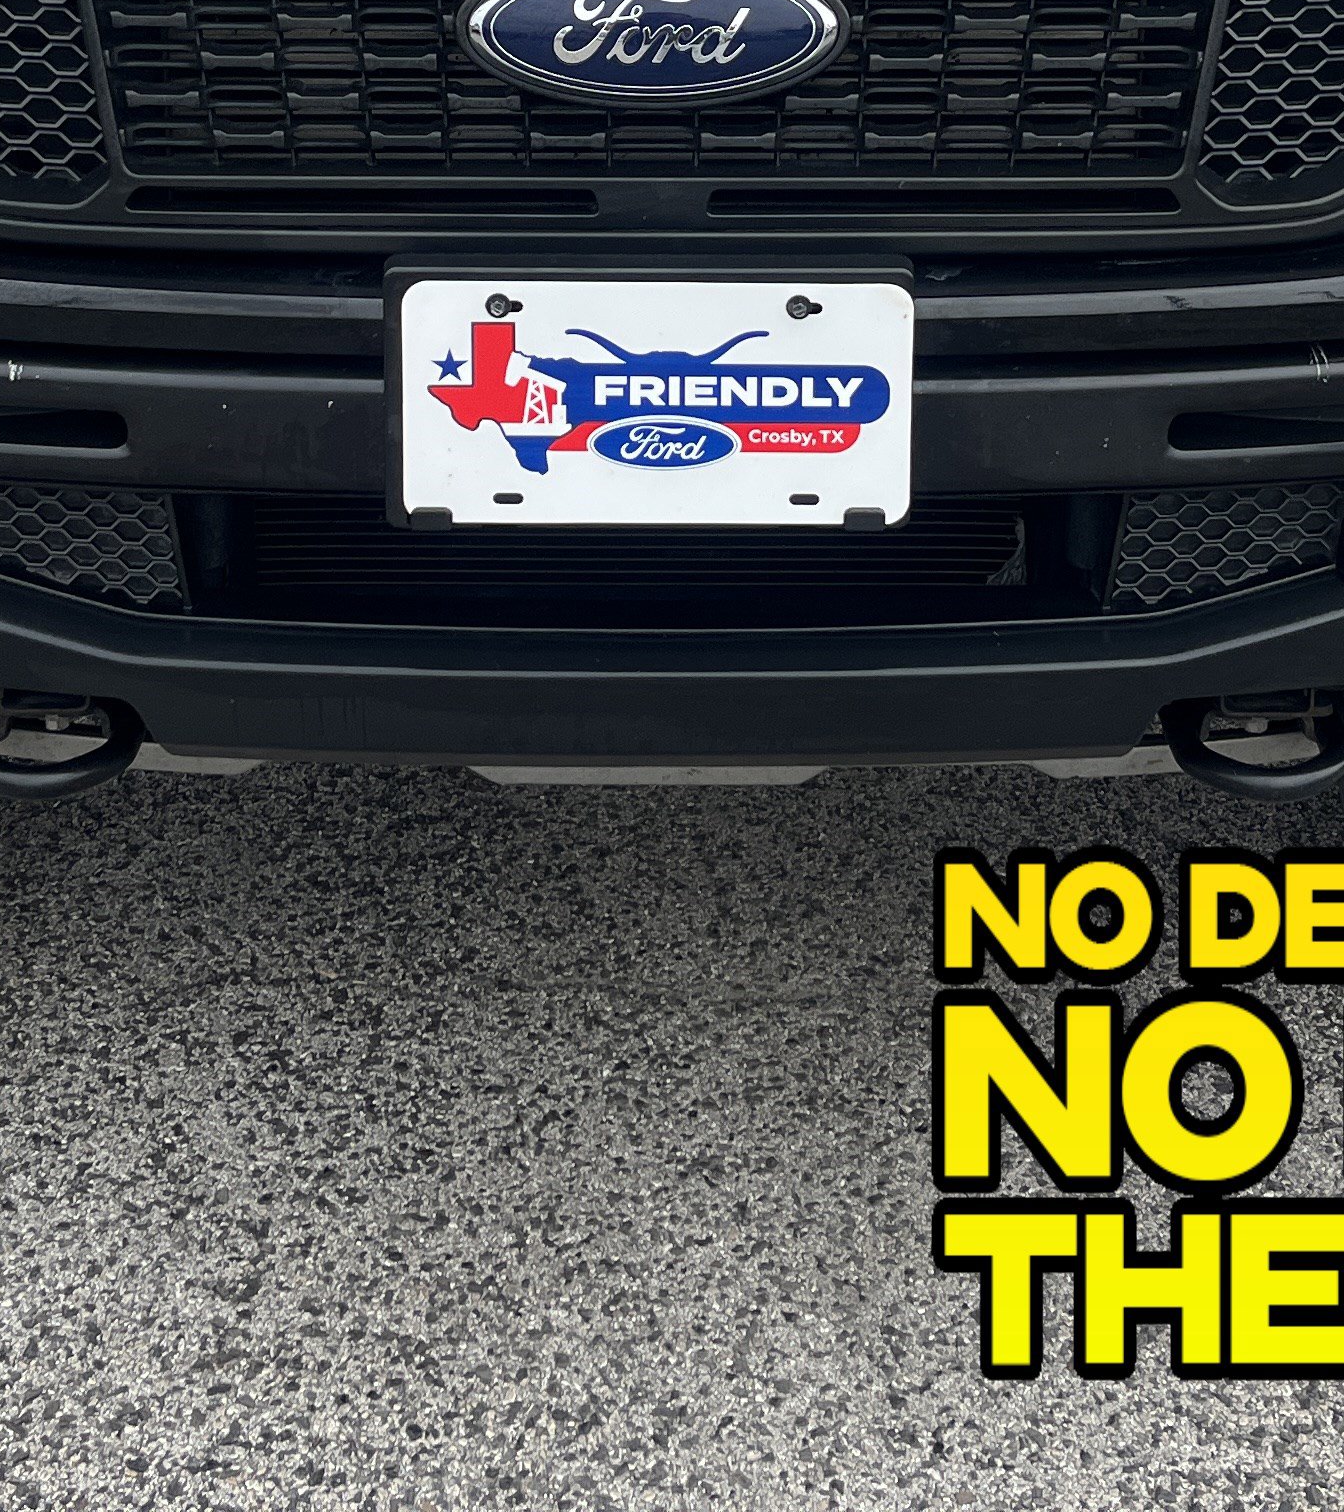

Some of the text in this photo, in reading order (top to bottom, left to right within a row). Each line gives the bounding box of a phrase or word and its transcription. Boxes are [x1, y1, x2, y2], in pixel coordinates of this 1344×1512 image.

[593, 375, 865, 409] FRIENDLY
[619, 425, 706, 461] Ford
[748, 428, 845, 447] Crosby, TX
